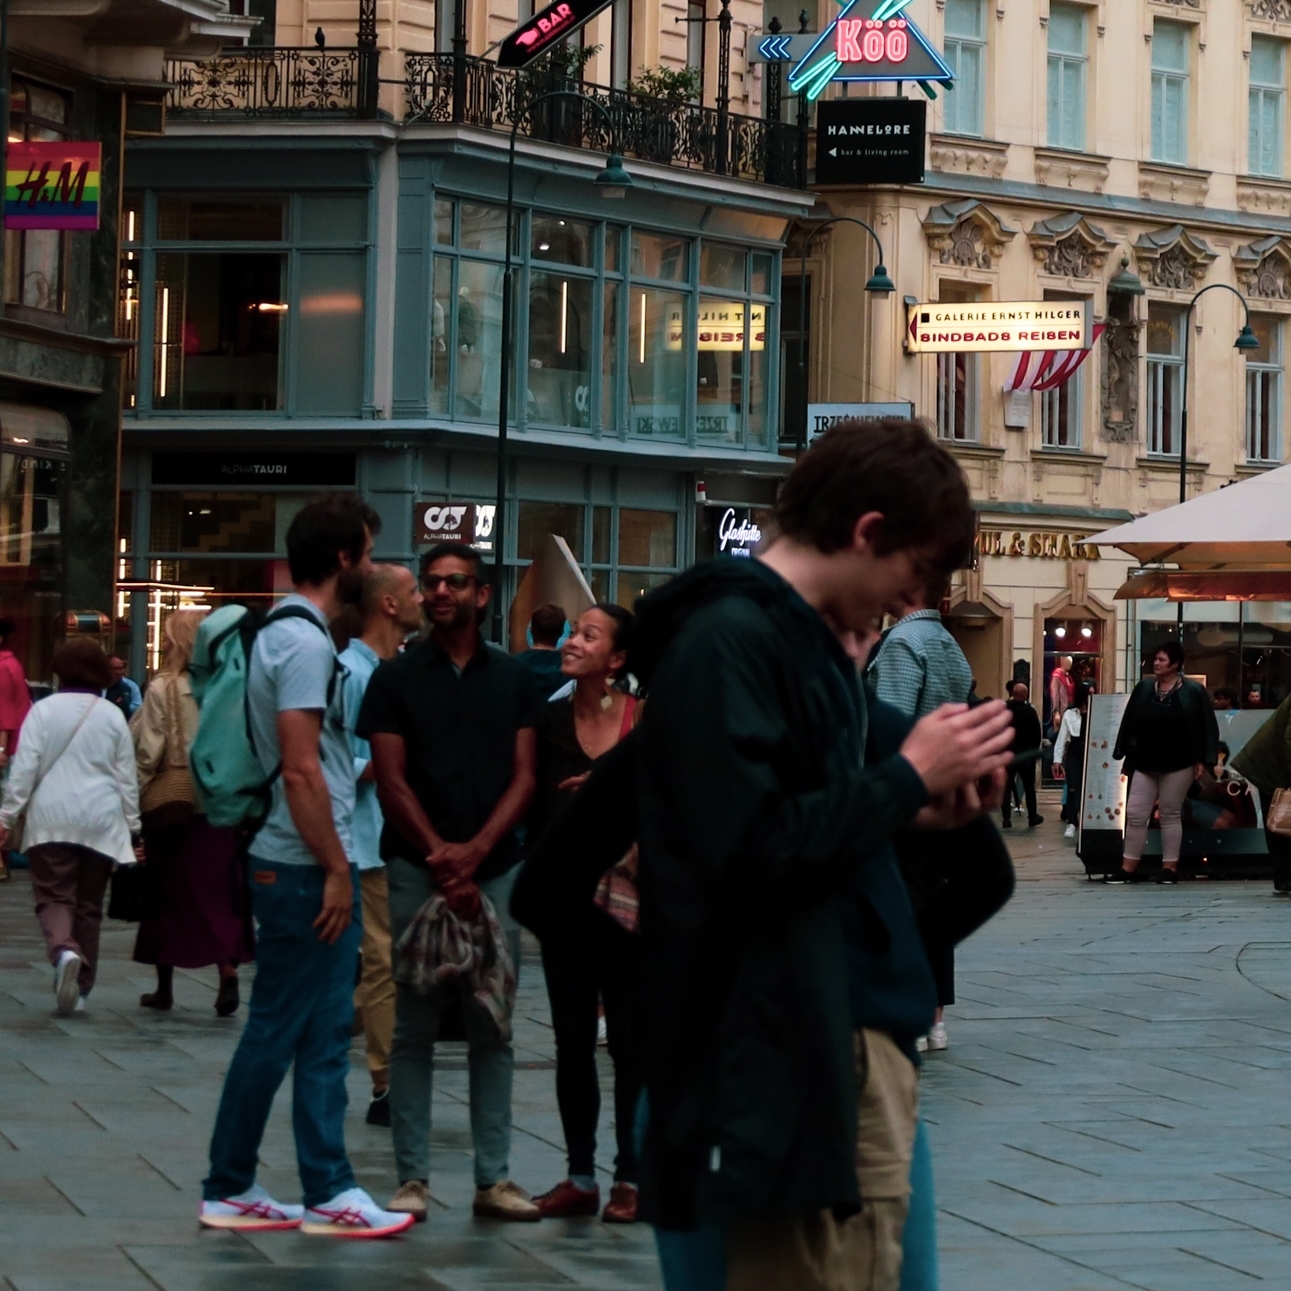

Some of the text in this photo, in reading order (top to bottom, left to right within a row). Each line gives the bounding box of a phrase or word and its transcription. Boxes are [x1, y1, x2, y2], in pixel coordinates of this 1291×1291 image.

[537, 3, 571, 34] BAR
[837, 19, 908, 63] Köö
[828, 125, 911, 136] HANNELORE
[841, 148, 850, 156] bar
[856, 148, 863, 156] &
[865, 148, 888, 157] living
[15, 160, 90, 209] H&M
[935, 310, 1081, 322] GALERIE ERNST HILGER
[920, 330, 1081, 342] SINDBADS REISEN
[221, 465, 287, 474] ALPHATAURI
[1009, 532, 1025, 556] &
